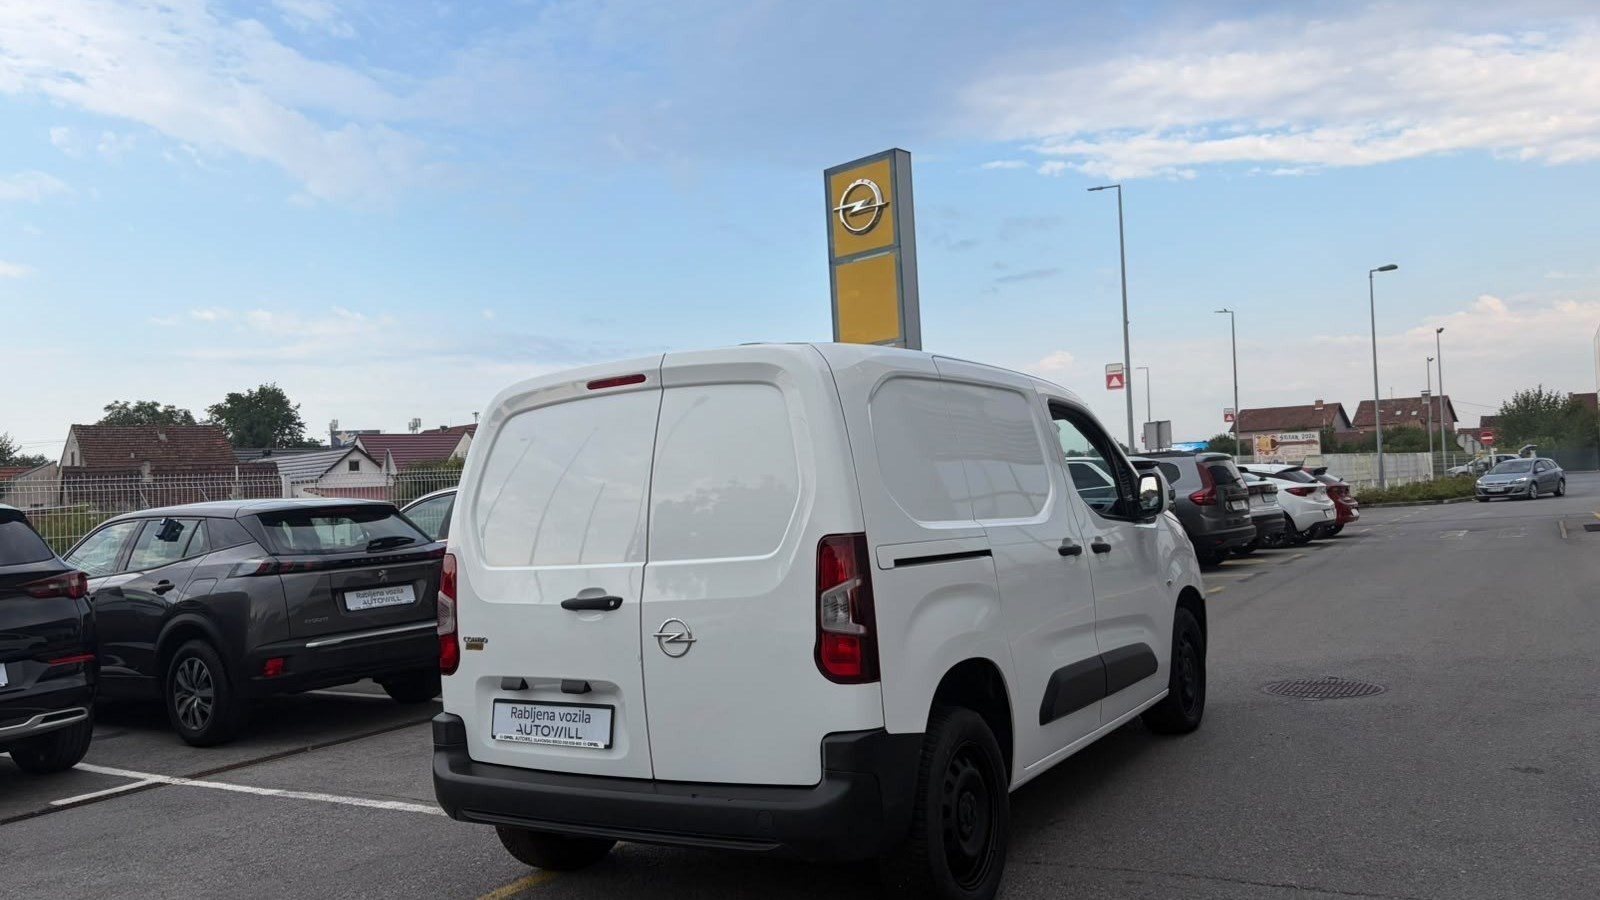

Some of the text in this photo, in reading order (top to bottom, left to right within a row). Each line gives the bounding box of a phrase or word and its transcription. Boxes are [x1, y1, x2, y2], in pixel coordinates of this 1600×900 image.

[510, 707, 591, 724] Rabljena vozila
[516, 723, 583, 740] AUTOWILL
